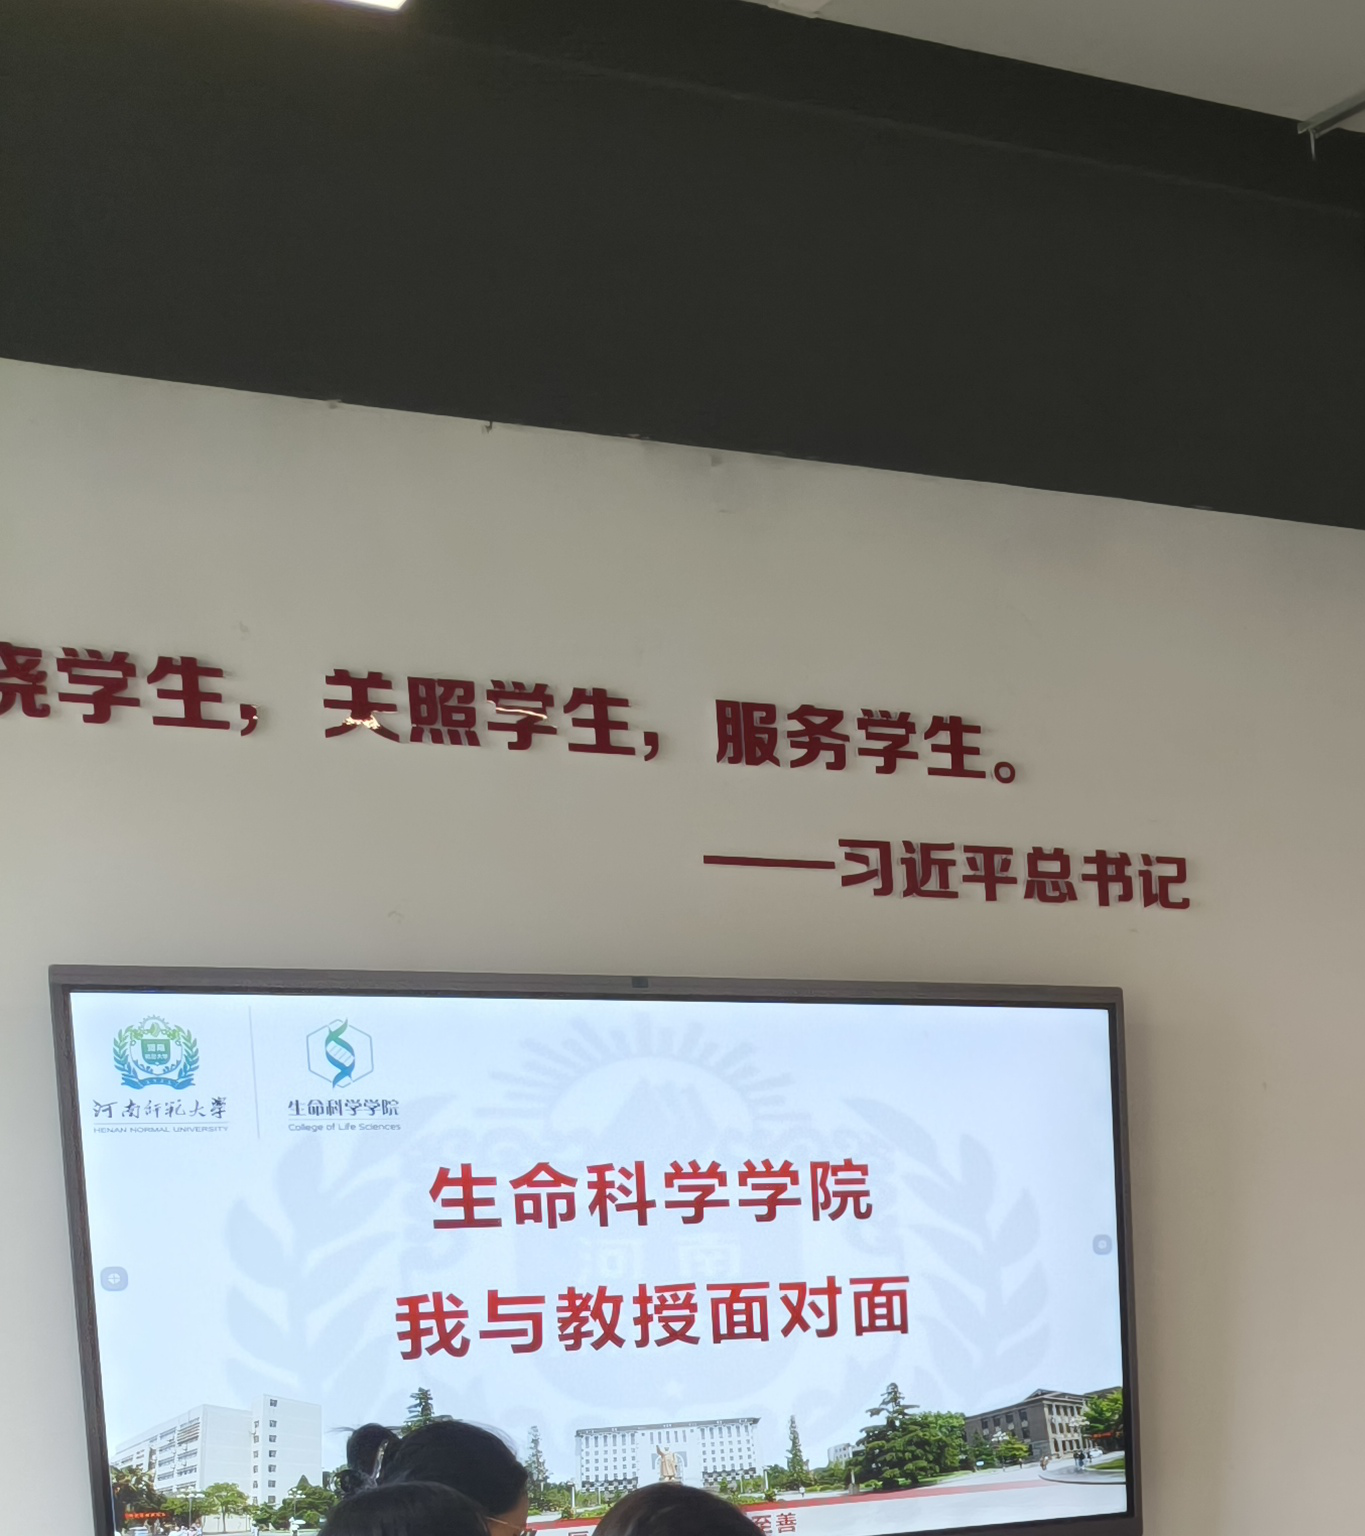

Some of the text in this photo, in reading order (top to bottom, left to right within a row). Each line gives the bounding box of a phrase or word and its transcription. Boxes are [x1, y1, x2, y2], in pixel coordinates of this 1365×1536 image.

[288, 1099, 400, 1116] 生命科学学院
[288, 1122, 401, 1133] College of Life Sciences
[428, 1158, 873, 1229] 生命科学学院
[395, 1275, 910, 1360] 我与教授面对面
